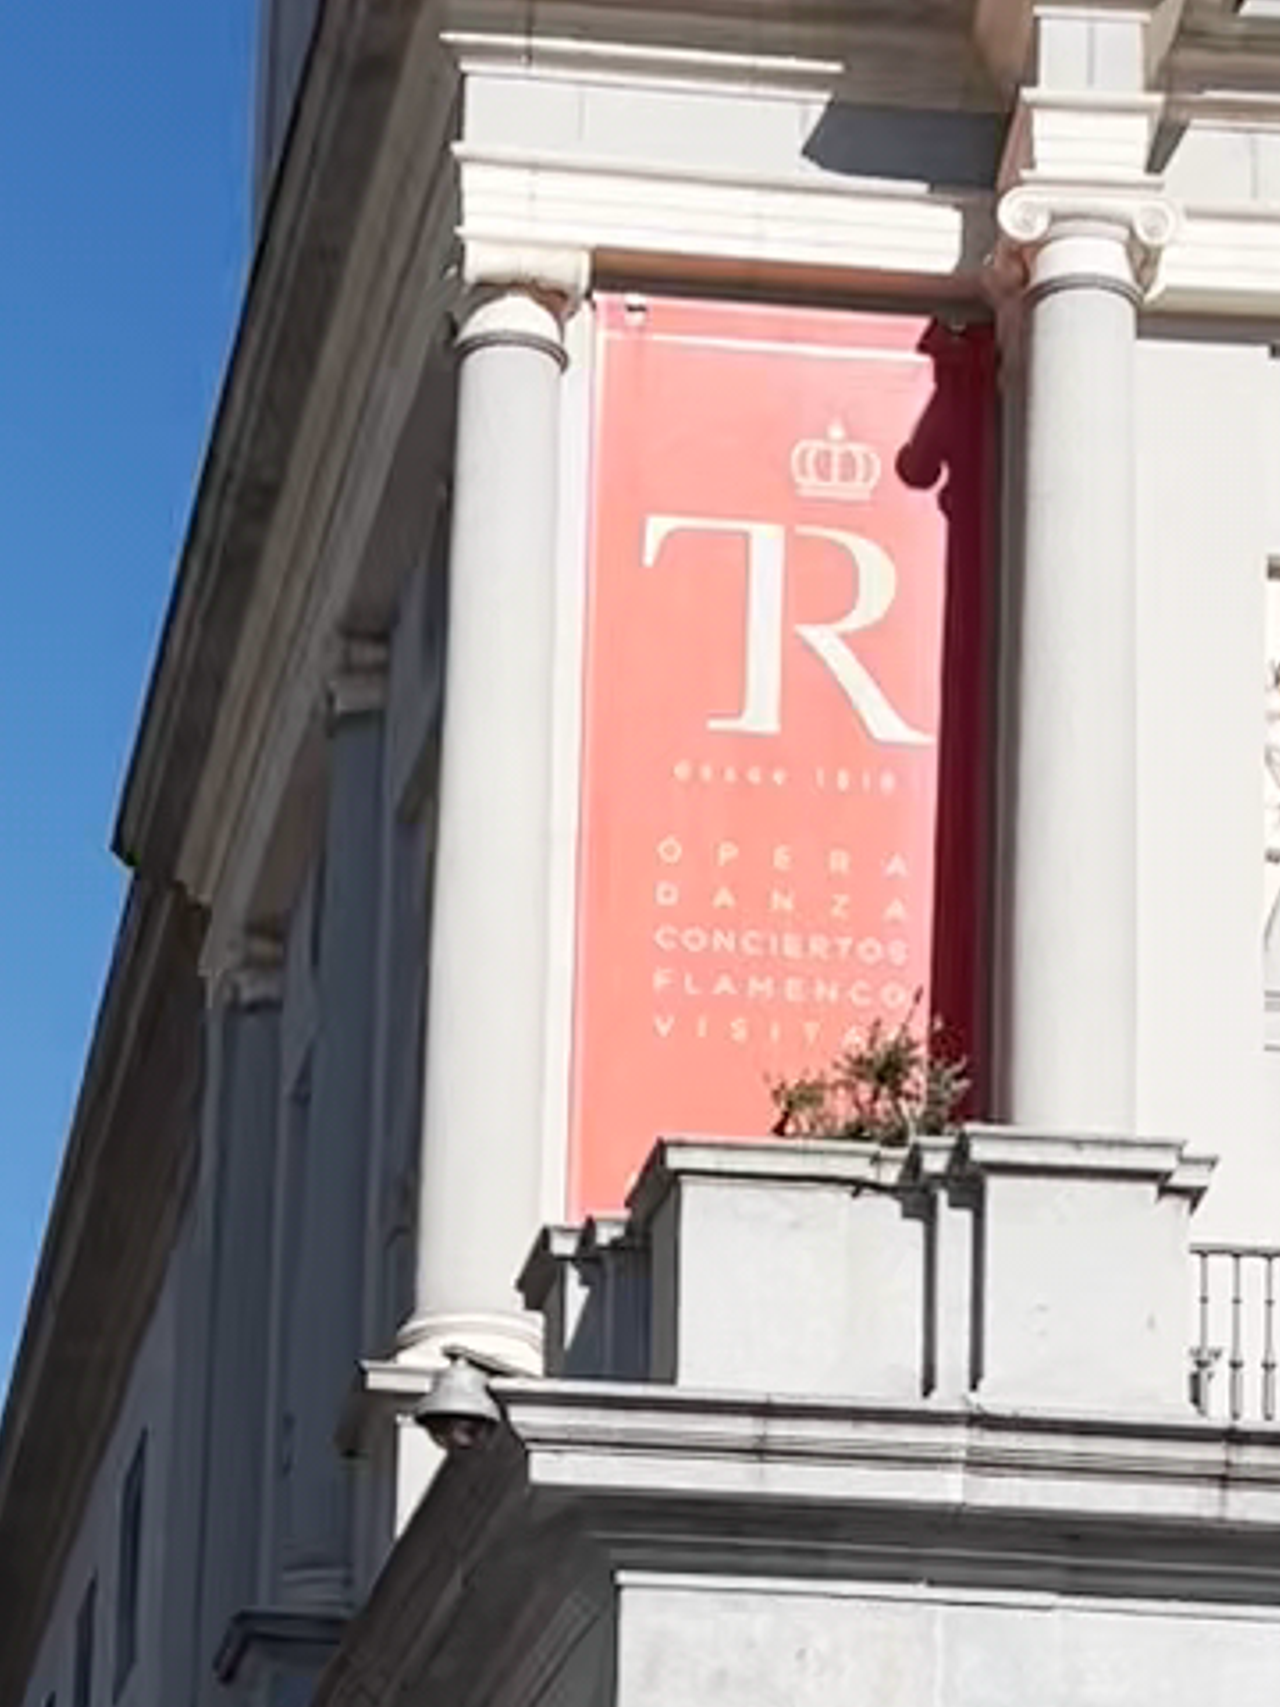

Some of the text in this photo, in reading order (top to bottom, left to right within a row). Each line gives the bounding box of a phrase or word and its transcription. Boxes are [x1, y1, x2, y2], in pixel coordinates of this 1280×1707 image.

[642, 514, 937, 745] TR
[656, 834, 907, 877] ÓPERA
[655, 881, 908, 921] DANZA
[654, 925, 909, 965] CONCIERTOS
[653, 966, 907, 1007] FLAMENCO
[654, 1015, 904, 1050] VISITA
